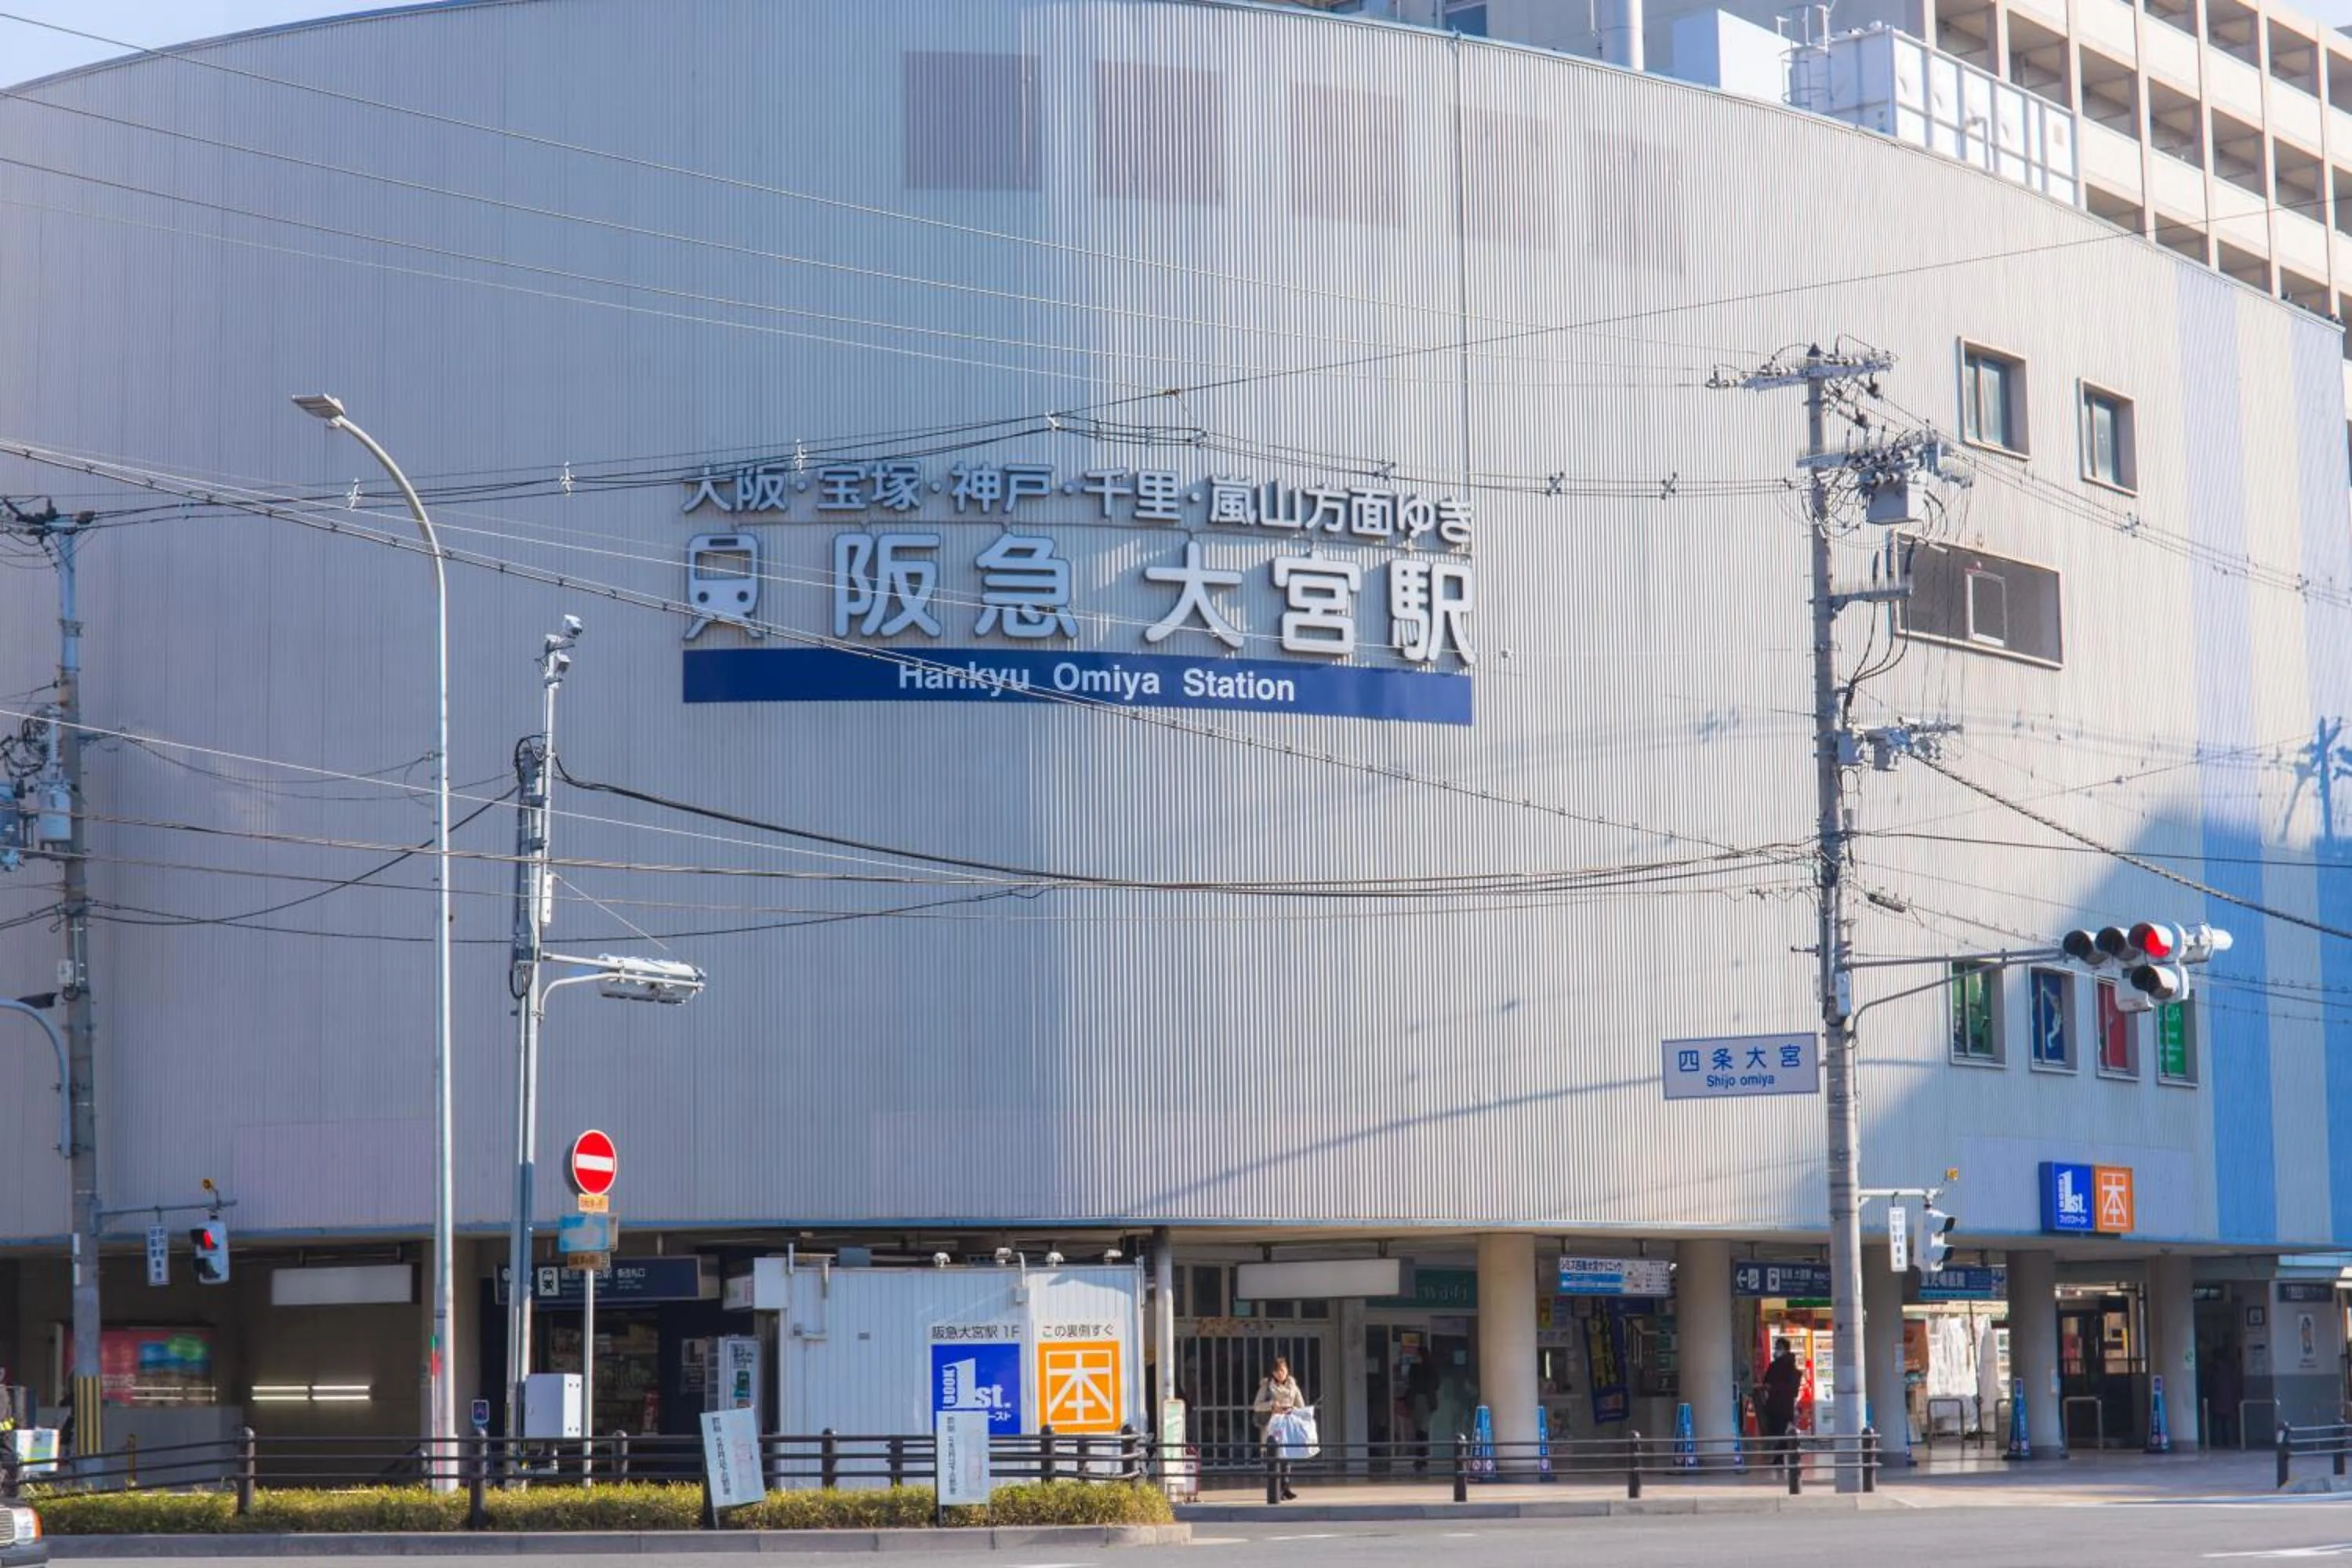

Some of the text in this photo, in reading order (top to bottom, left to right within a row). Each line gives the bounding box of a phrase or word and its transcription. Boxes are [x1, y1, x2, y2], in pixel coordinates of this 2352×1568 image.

[833, 532, 1478, 665] 阪急 大宮駅
[898, 662, 1296, 703] Hankyu Omiya Station
[1678, 1044, 1801, 1073] 四条大宮
[1706, 1074, 1775, 1089] Shijo omiya
[931, 1325, 1021, 1340] 阪急大宮駅 1F
[1042, 1323, 1114, 1338] この裏側すぐ
[942, 1369, 956, 1405] BOOK
